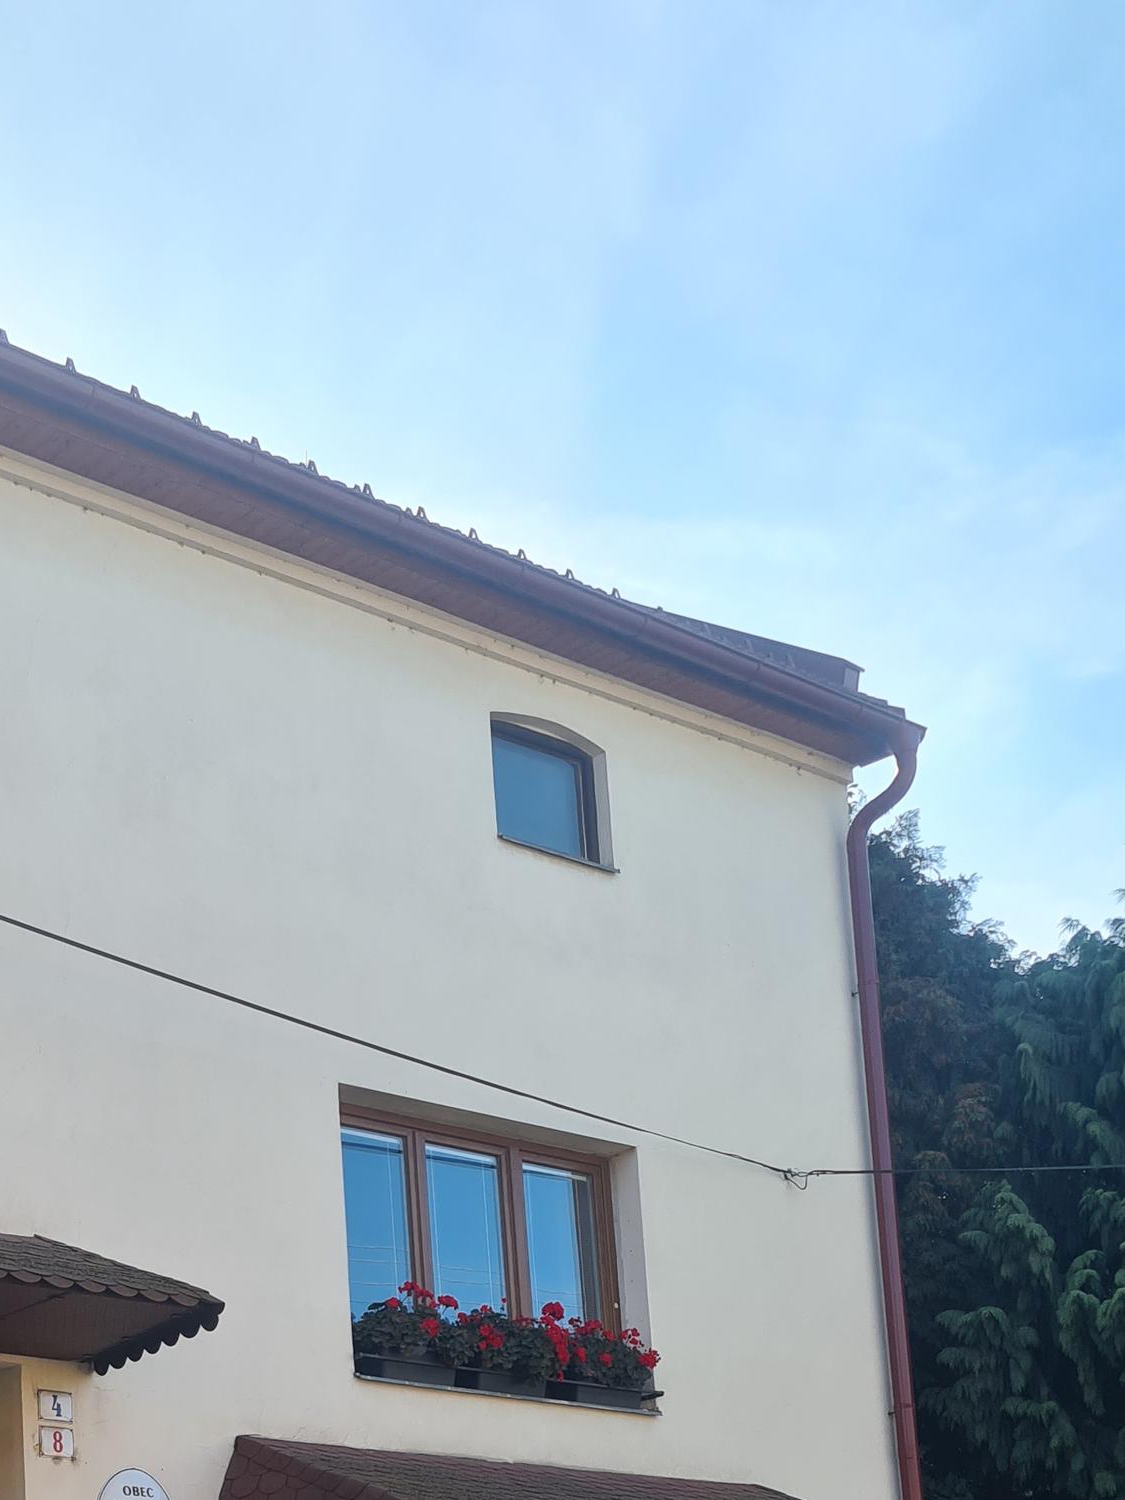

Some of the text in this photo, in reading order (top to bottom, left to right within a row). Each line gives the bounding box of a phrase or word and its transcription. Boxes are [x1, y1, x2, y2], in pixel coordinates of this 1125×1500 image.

[52, 1394, 62, 1417] 4
[53, 1430, 63, 1453] 8
[122, 1485, 155, 1498] OBEC
